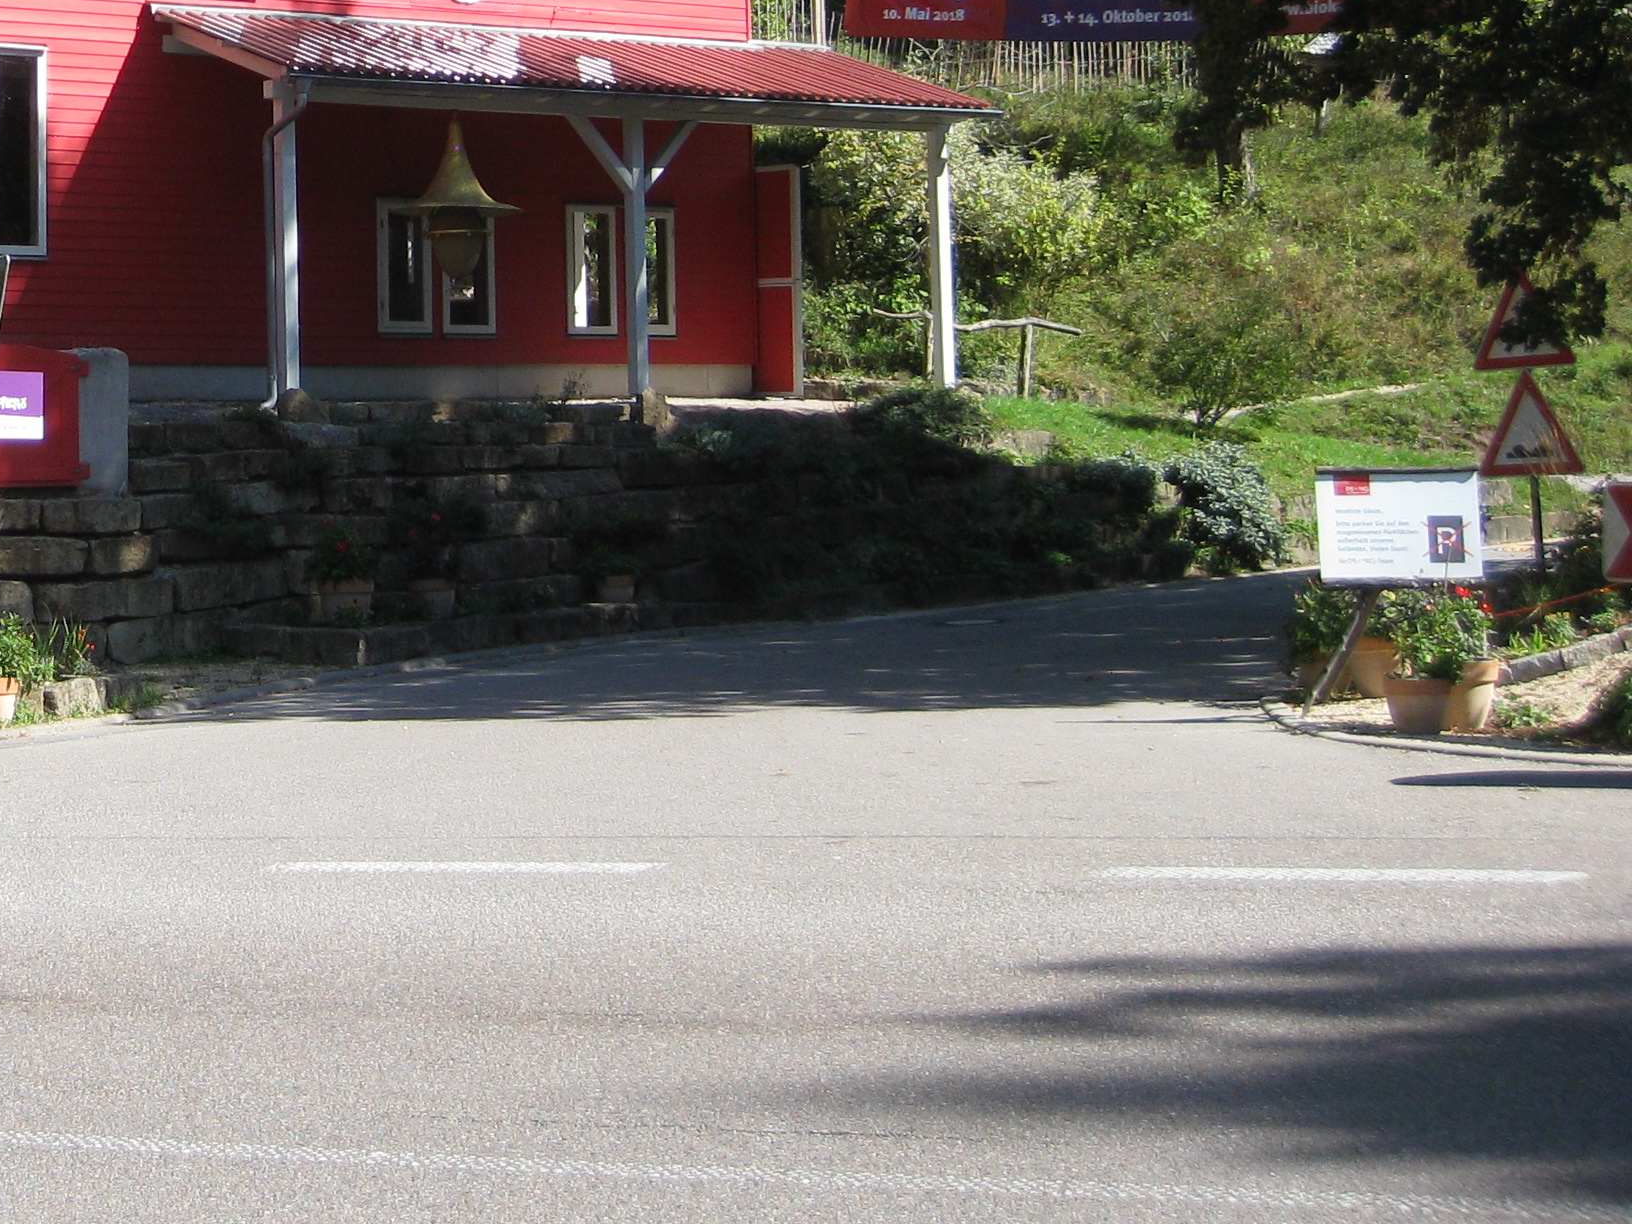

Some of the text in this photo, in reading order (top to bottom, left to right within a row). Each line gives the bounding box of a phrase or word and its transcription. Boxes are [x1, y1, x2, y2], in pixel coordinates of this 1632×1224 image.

[882, 7, 965, 21] 10. Mai 2018
[1040, 12, 1060, 26] 13.
[1064, 11, 1074, 24] +
[1077, 12, 1098, 26] 14.
[1102, 8, 1160, 24] Oktober
